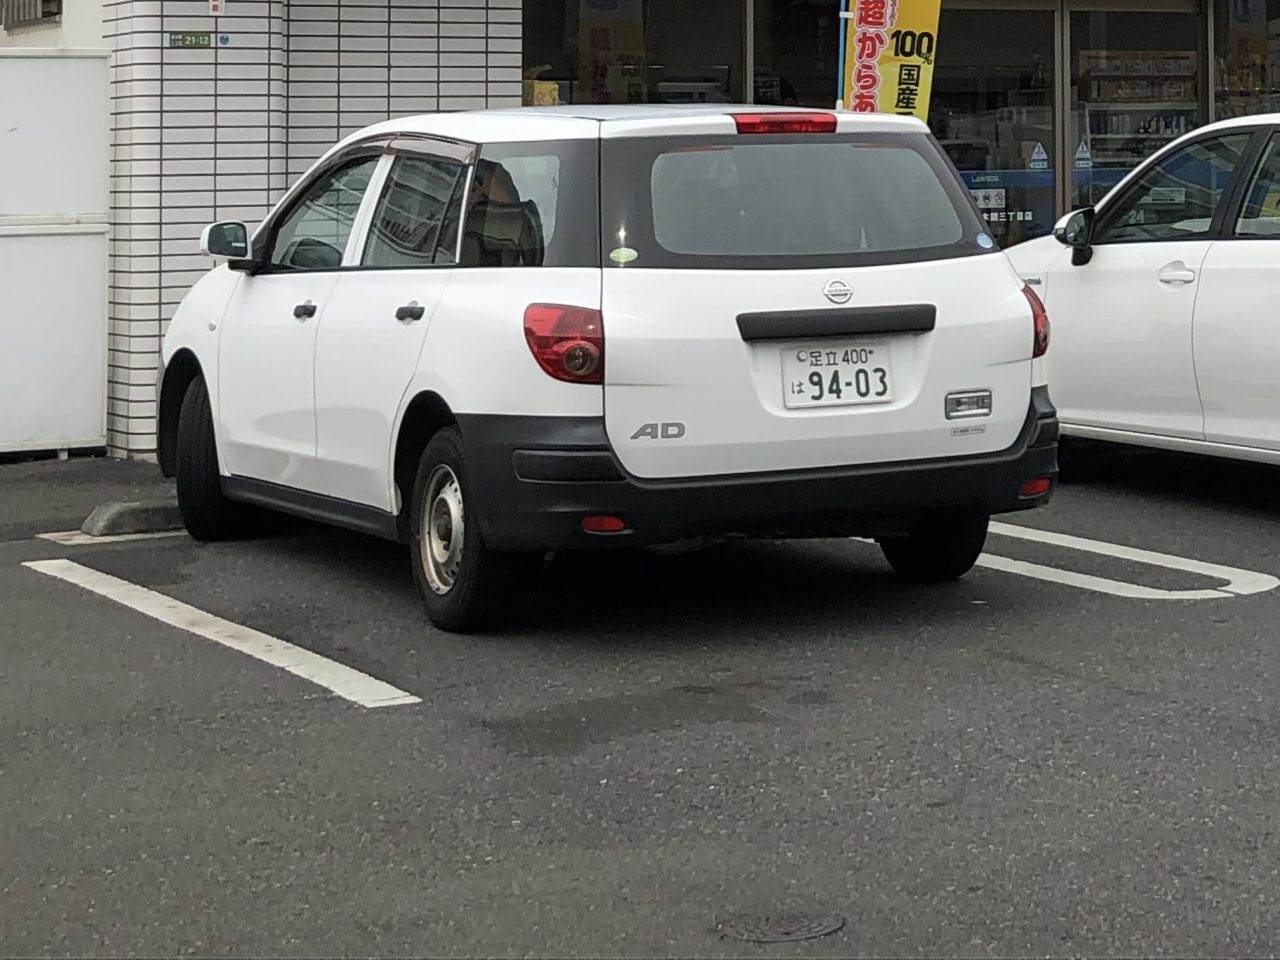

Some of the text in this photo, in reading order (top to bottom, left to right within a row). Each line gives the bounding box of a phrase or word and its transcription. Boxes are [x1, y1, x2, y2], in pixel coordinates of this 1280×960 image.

[894, 63, 922, 115] 国産
[809, 348, 868, 367] 足立 400
[791, 367, 888, 401] は 94-03
[630, 422, 686, 440] AD
